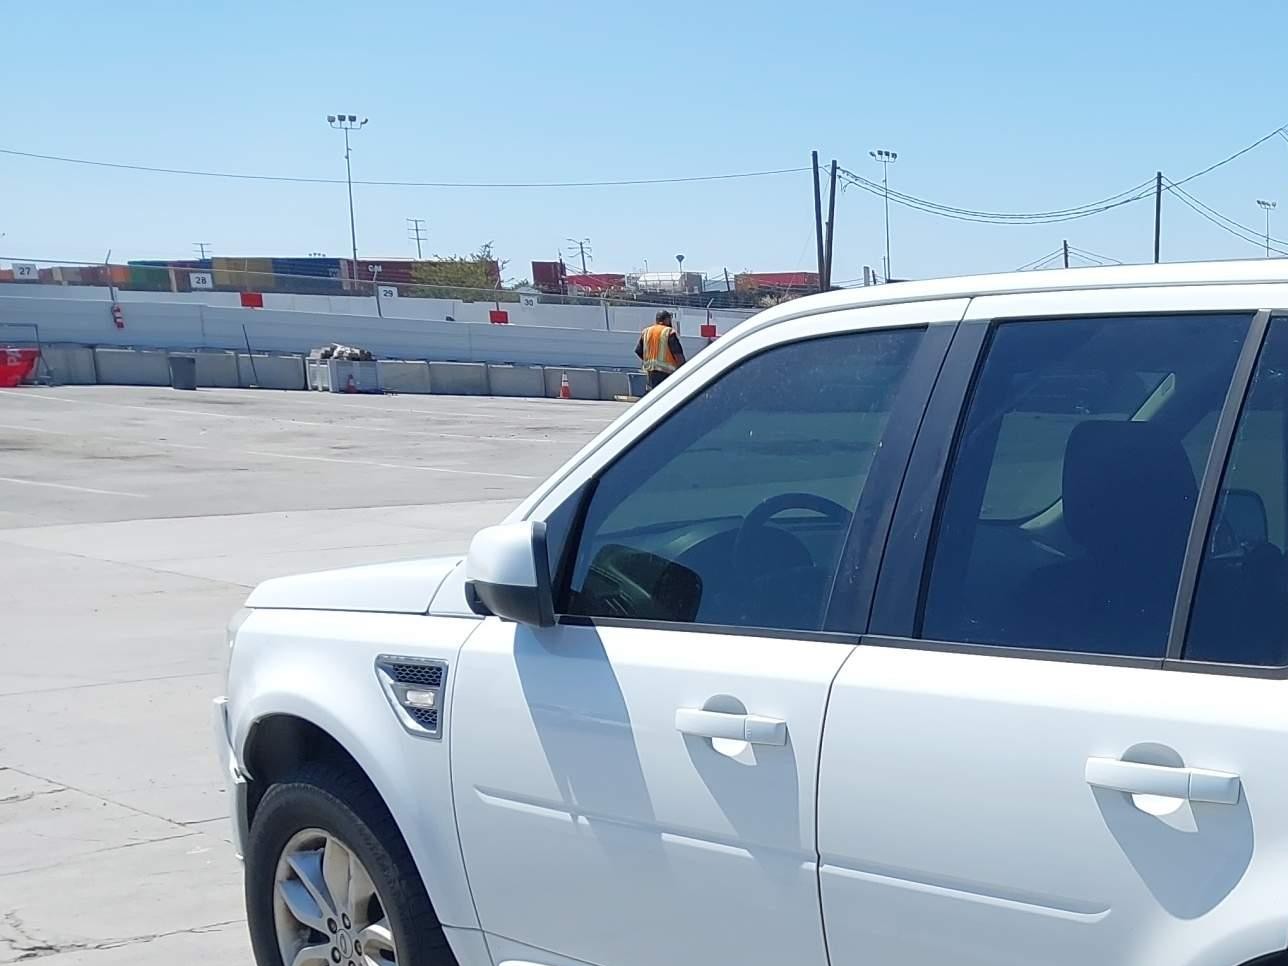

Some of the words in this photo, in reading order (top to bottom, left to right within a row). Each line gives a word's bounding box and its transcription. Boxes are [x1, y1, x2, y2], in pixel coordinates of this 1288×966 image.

[19, 266, 31, 276] 27
[195, 276, 207, 285] 28
[383, 289, 394, 298] 29
